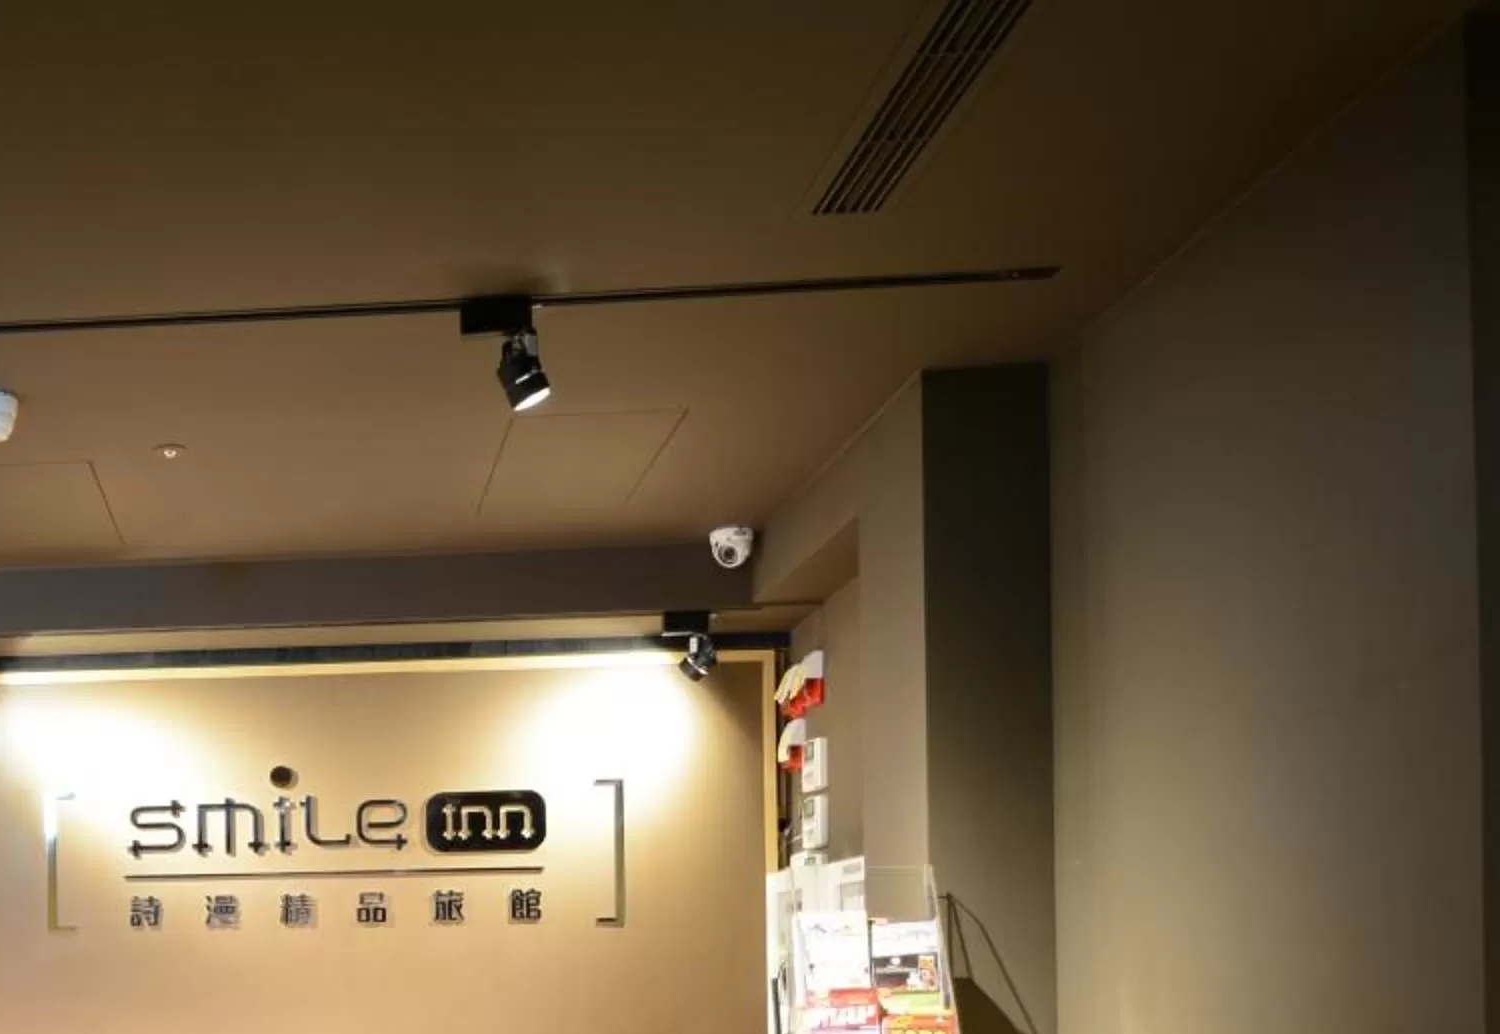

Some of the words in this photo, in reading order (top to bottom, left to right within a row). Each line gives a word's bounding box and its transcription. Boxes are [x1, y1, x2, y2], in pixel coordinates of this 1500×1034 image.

[438, 797, 536, 842] inn
[130, 888, 543, 928] 詩漫精品旅館
